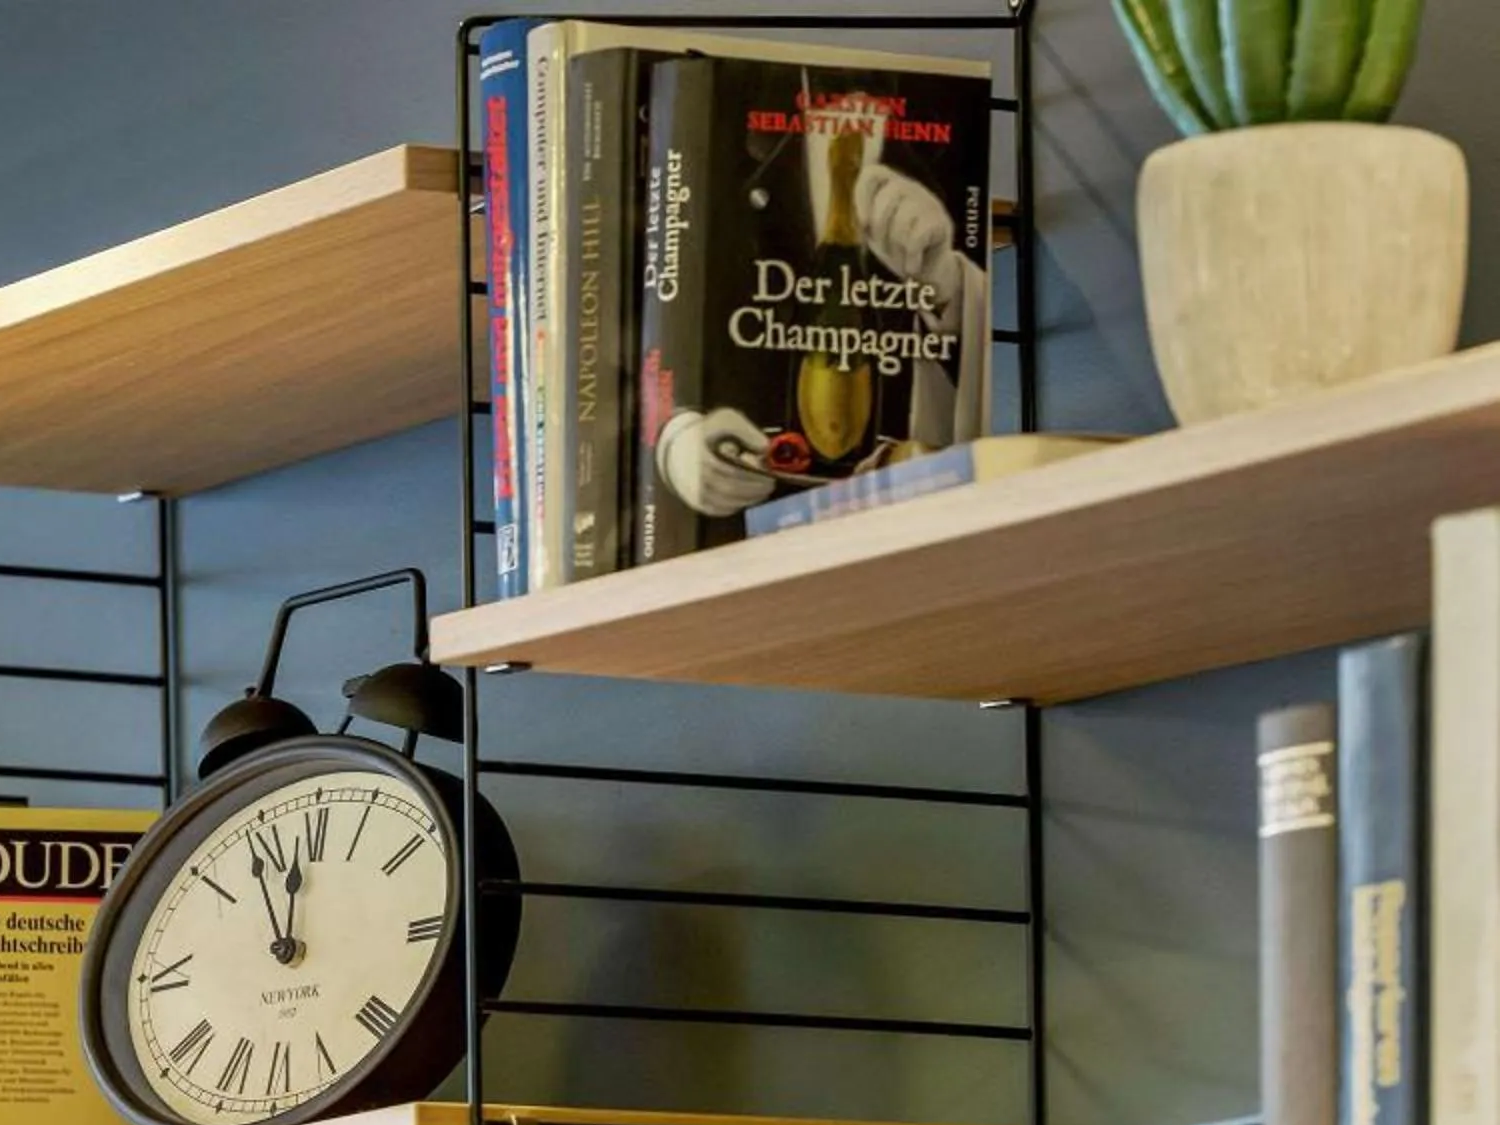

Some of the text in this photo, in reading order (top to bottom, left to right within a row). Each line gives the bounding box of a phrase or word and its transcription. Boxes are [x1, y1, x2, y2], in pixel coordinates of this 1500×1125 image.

[532, 56, 549, 170] Computer
[747, 111, 952, 143] SEBASTIAN HENN
[583, 200, 601, 260] HILL
[645, 167, 661, 289] Der letzte
[657, 149, 690, 302] Champagner
[535, 231, 550, 322] Internet
[753, 260, 937, 312] Der letzte
[578, 270, 601, 422] NAPOLEON
[729, 307, 957, 375] Champagner
[6, 911, 86, 932] deutsche
